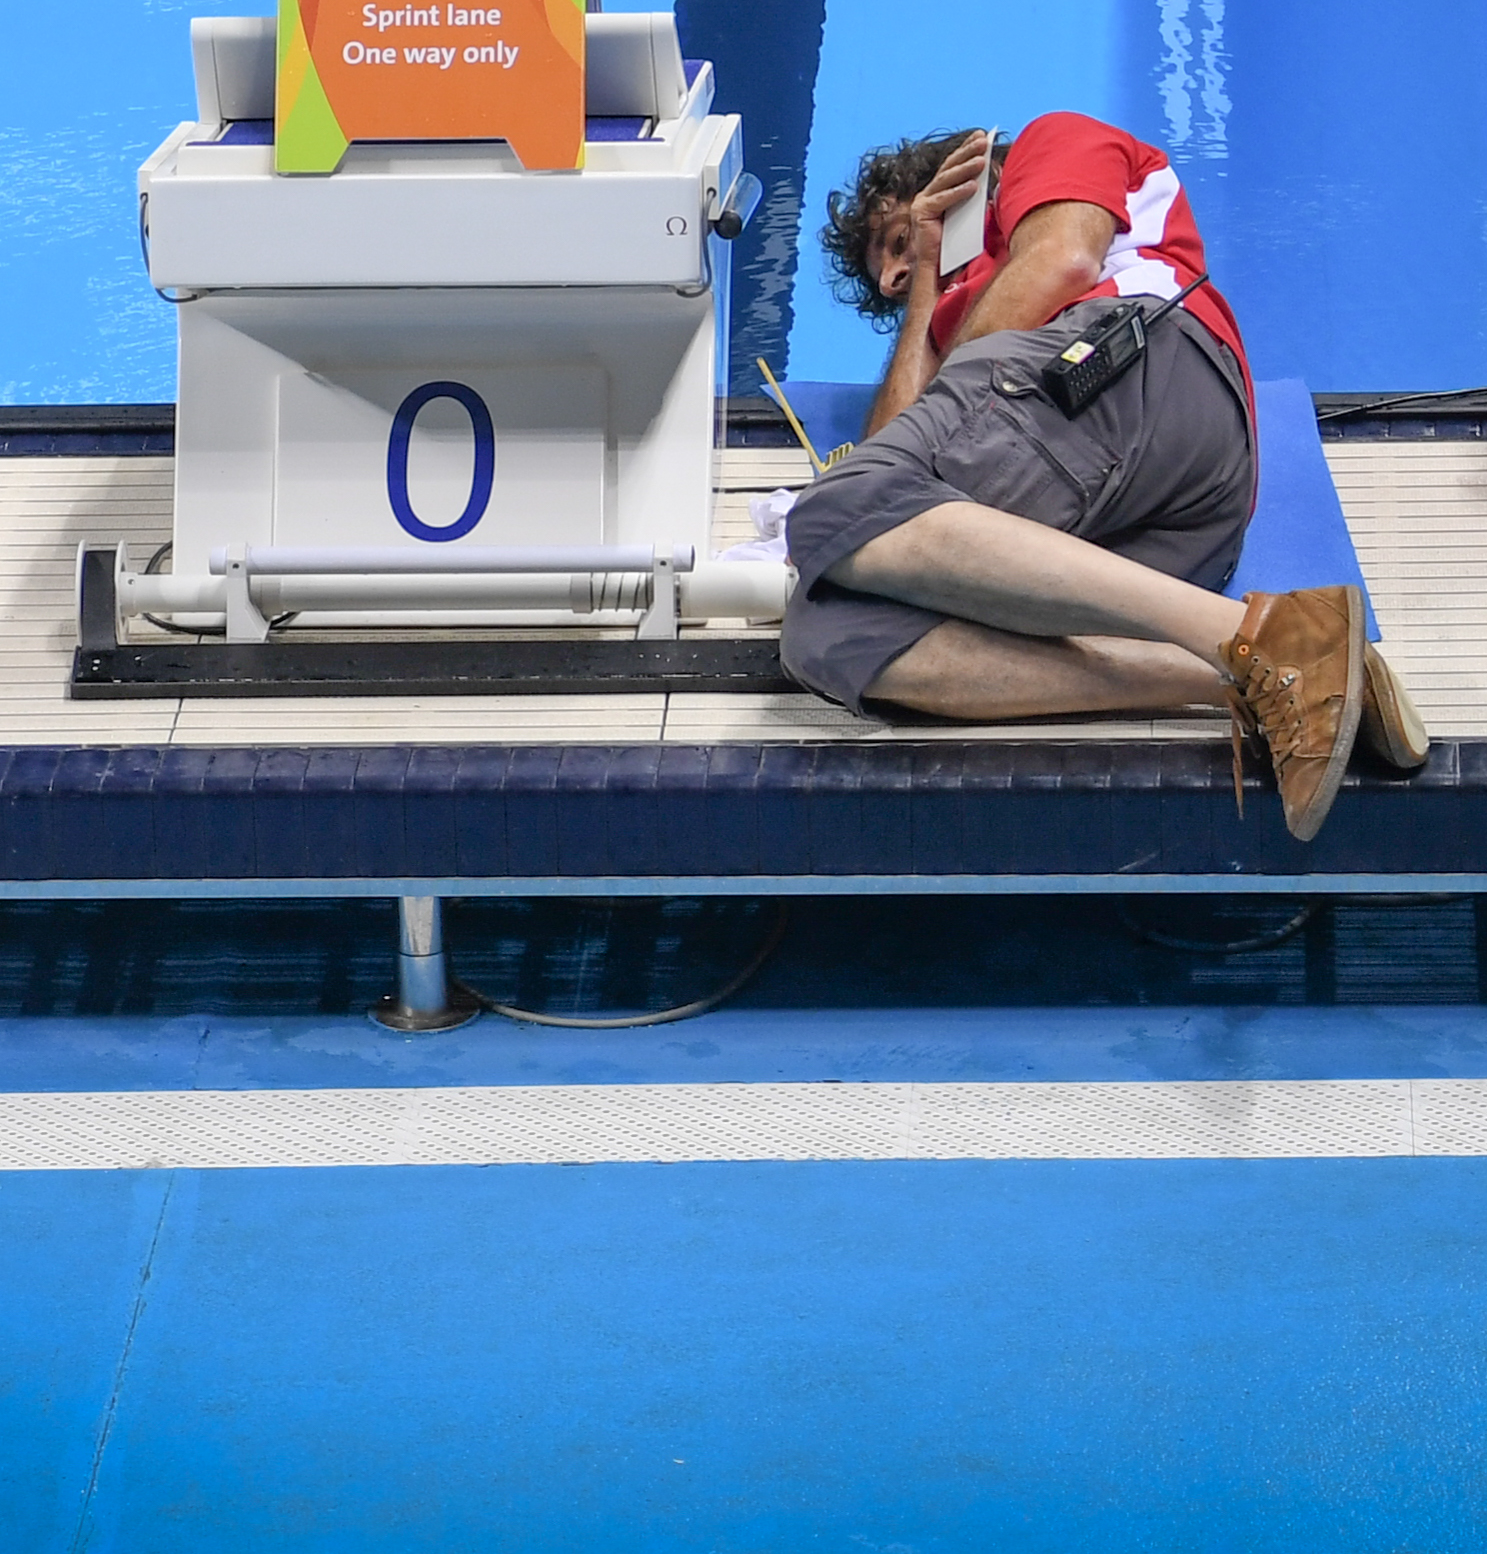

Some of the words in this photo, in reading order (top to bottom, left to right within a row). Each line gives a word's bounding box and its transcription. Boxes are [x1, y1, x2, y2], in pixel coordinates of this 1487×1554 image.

[362, 3, 440, 33] Sprint
[447, 3, 501, 26] lane
[342, 41, 397, 65] One
[403, 46, 456, 70] way
[463, 40, 519, 69] only
[387, 380, 496, 543] 0
